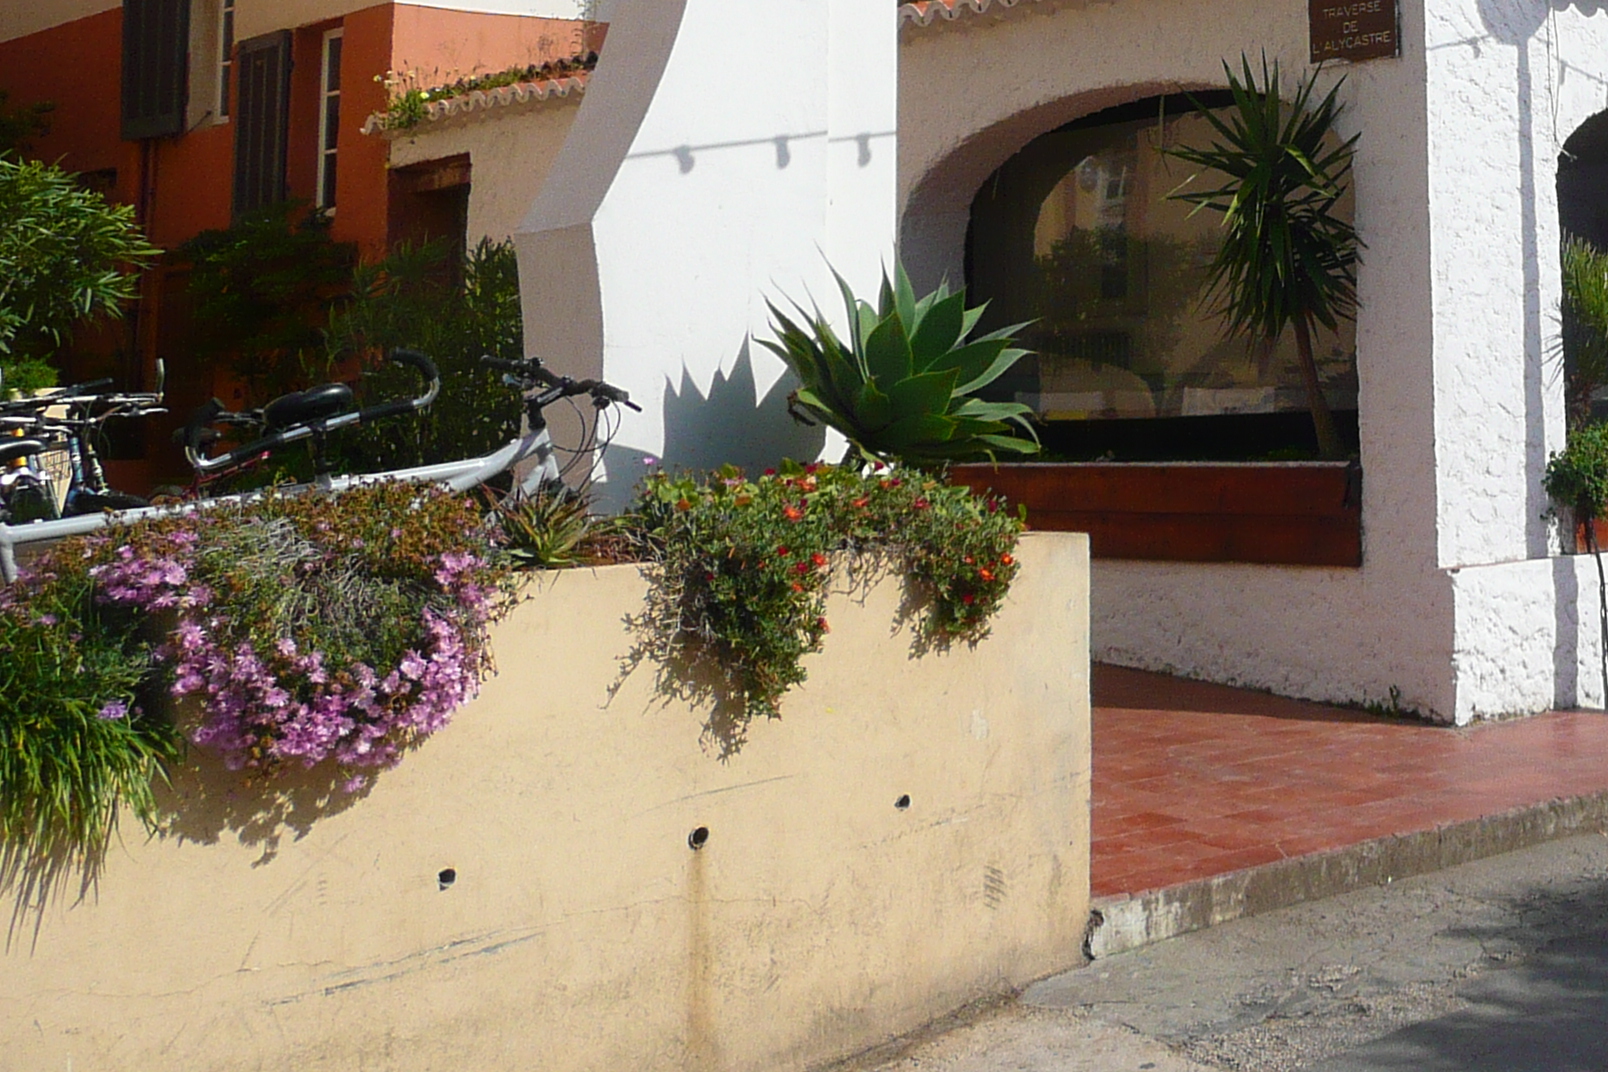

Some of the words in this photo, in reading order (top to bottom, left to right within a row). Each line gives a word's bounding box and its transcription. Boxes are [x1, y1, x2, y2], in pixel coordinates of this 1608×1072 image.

[1323, 0, 1381, 18] TRAVERSE
[1343, 20, 1358, 34] DE
[1313, 31, 1391, 54] L'ALYCASTRE
